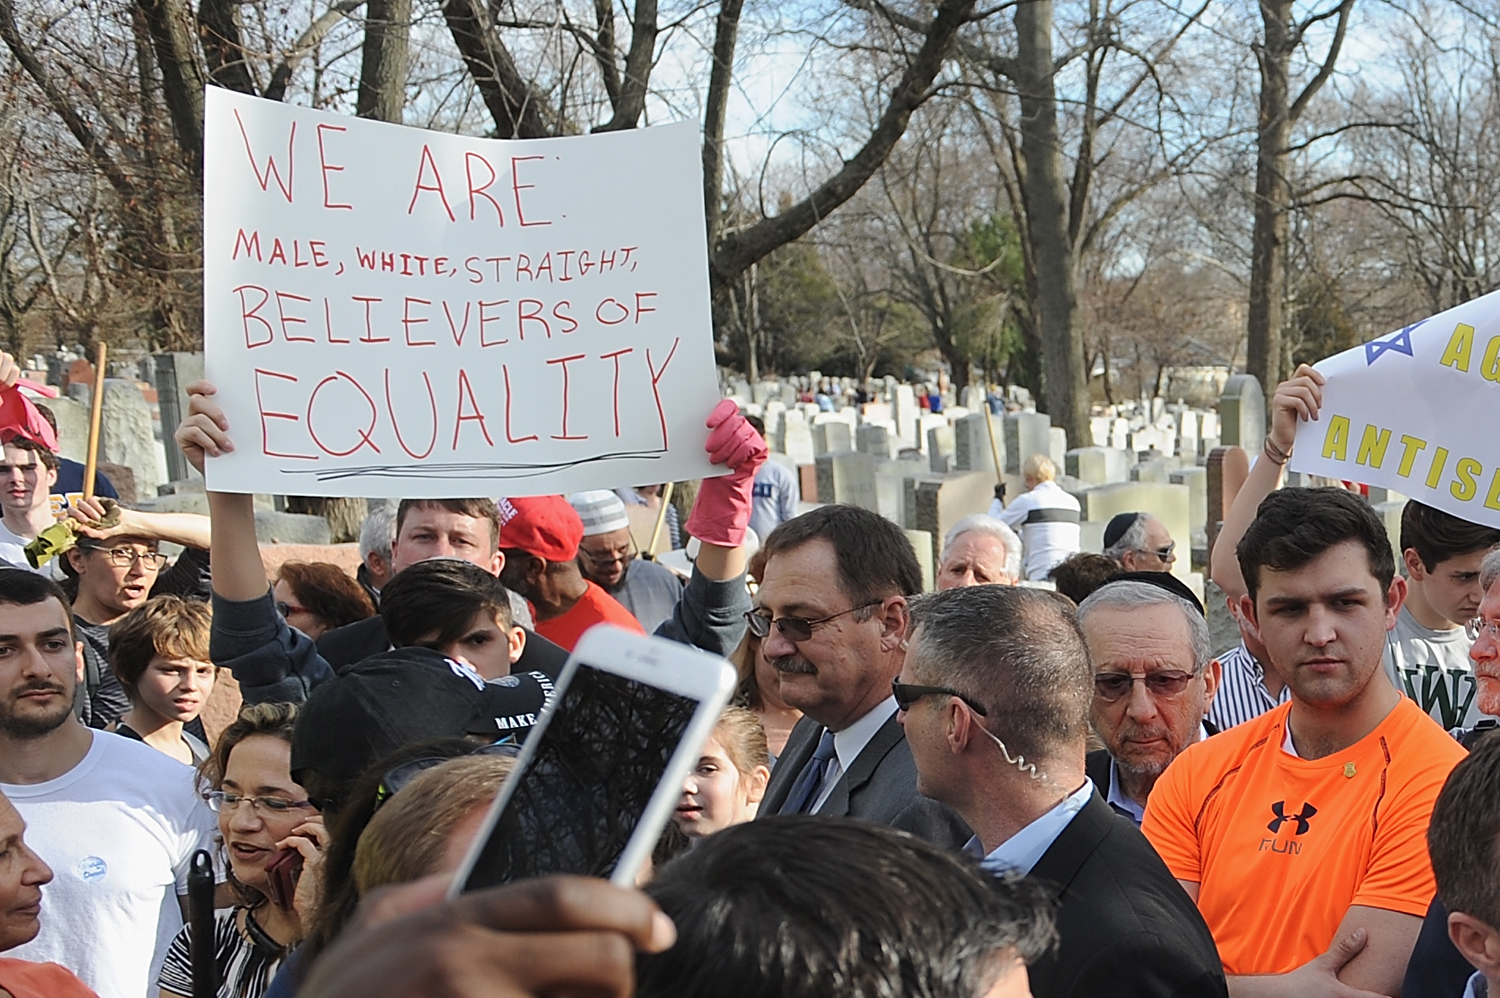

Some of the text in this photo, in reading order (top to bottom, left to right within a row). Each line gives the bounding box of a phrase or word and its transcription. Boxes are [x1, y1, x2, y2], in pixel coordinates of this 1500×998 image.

[235, 109, 352, 209] WE
[232, 229, 639, 282] MALE, WHITE, STRAIGHT,
[233, 286, 657, 348] BELIEVERS OF
[255, 337, 679, 459] EQUALITY
[495, 713, 538, 729] MAKE
[1259, 838, 1303, 855] RUN
